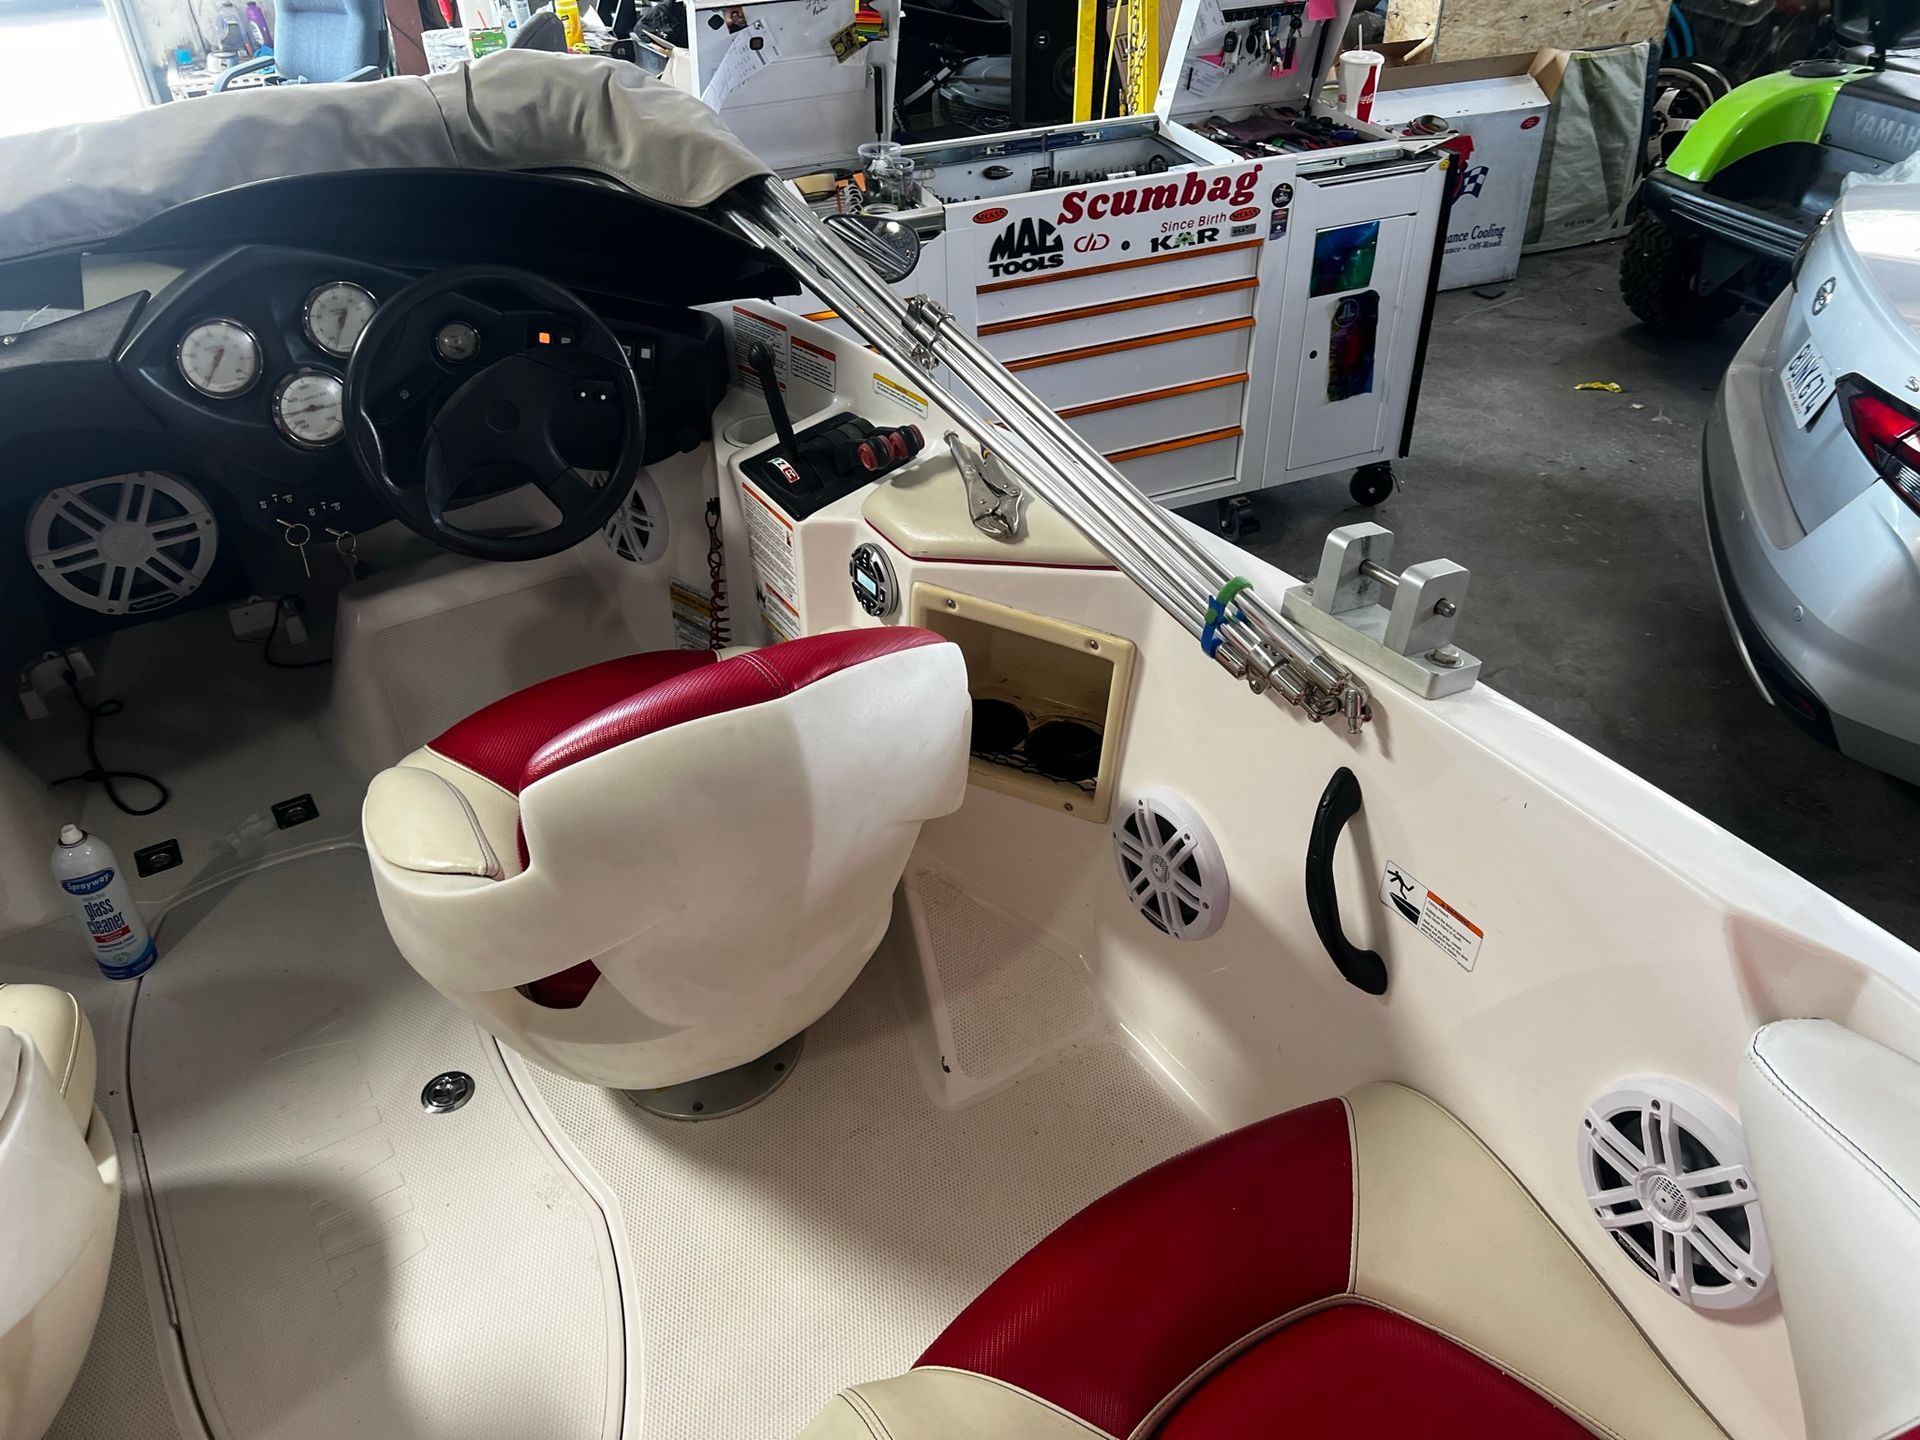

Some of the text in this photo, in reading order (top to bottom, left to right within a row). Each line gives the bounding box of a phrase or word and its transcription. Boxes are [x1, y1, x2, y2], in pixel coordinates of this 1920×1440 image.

[1057, 164, 1263, 225] Scumbag
[1160, 219, 1195, 233] Since
[1199, 212, 1227, 226] Birth
[1471, 223, 1506, 240] Cooling
[989, 217, 1064, 262] MAC
[988, 254, 1064, 277] TOOLS
[67, 873, 110, 892] Sprayway
[84, 898, 114, 920] glass
[86, 911, 126, 935] cleaner
